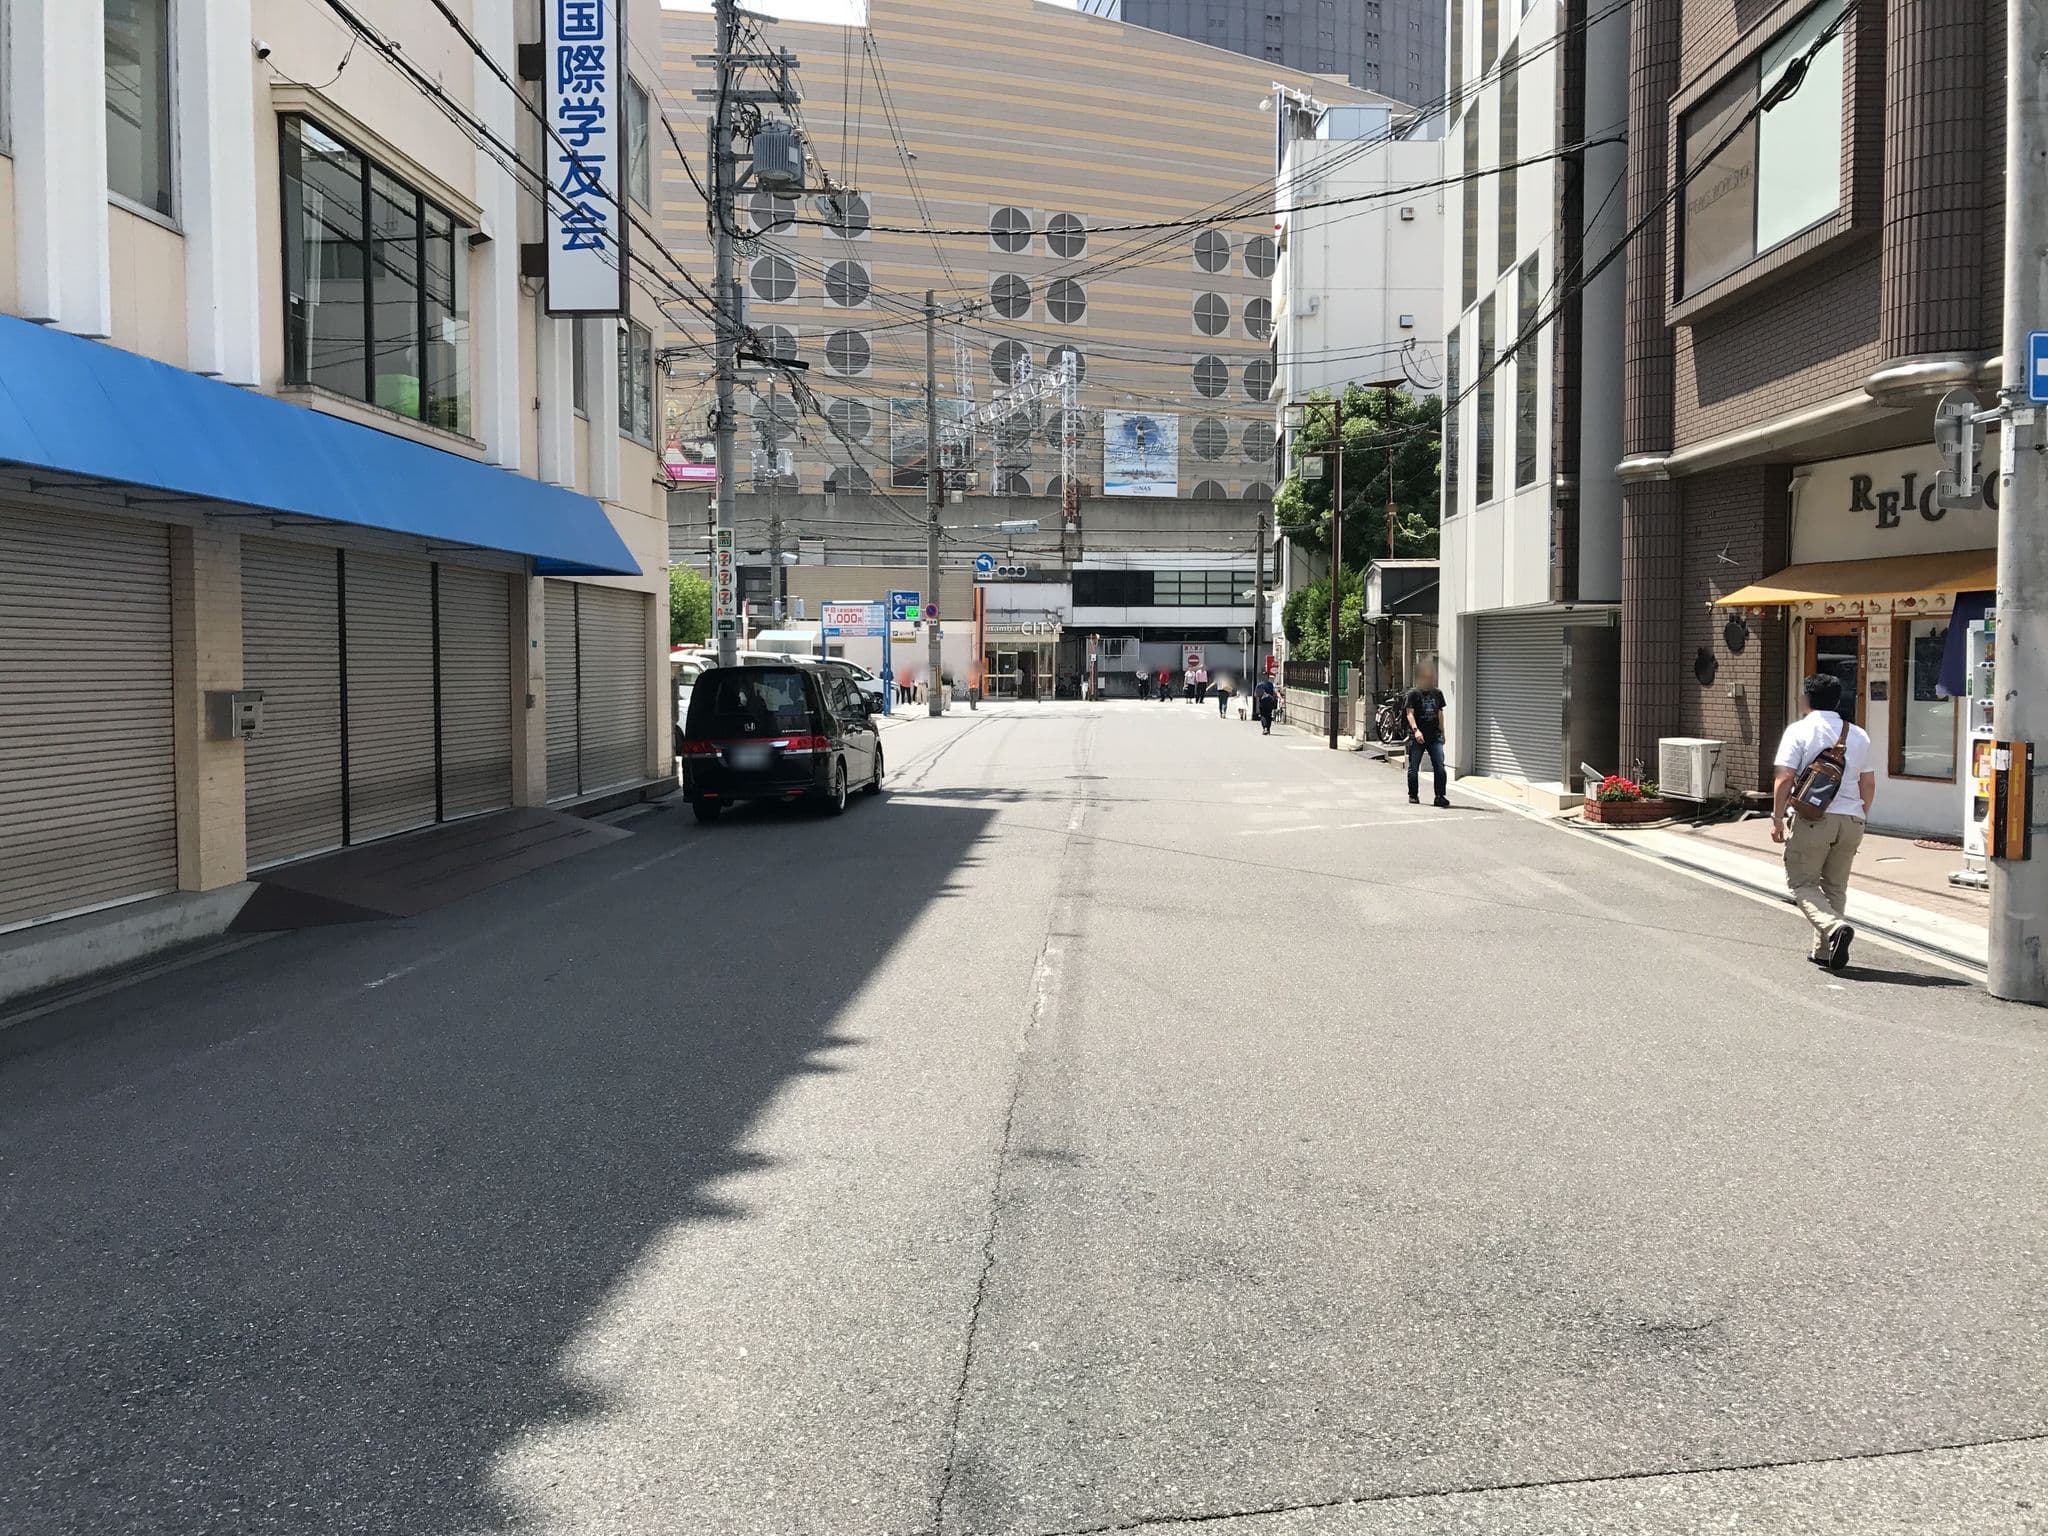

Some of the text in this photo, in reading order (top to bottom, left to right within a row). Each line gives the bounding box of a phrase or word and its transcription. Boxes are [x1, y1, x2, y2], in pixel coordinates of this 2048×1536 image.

[557, 0, 606, 251] 国際学友会
[1021, 621, 1061, 635] CITY
